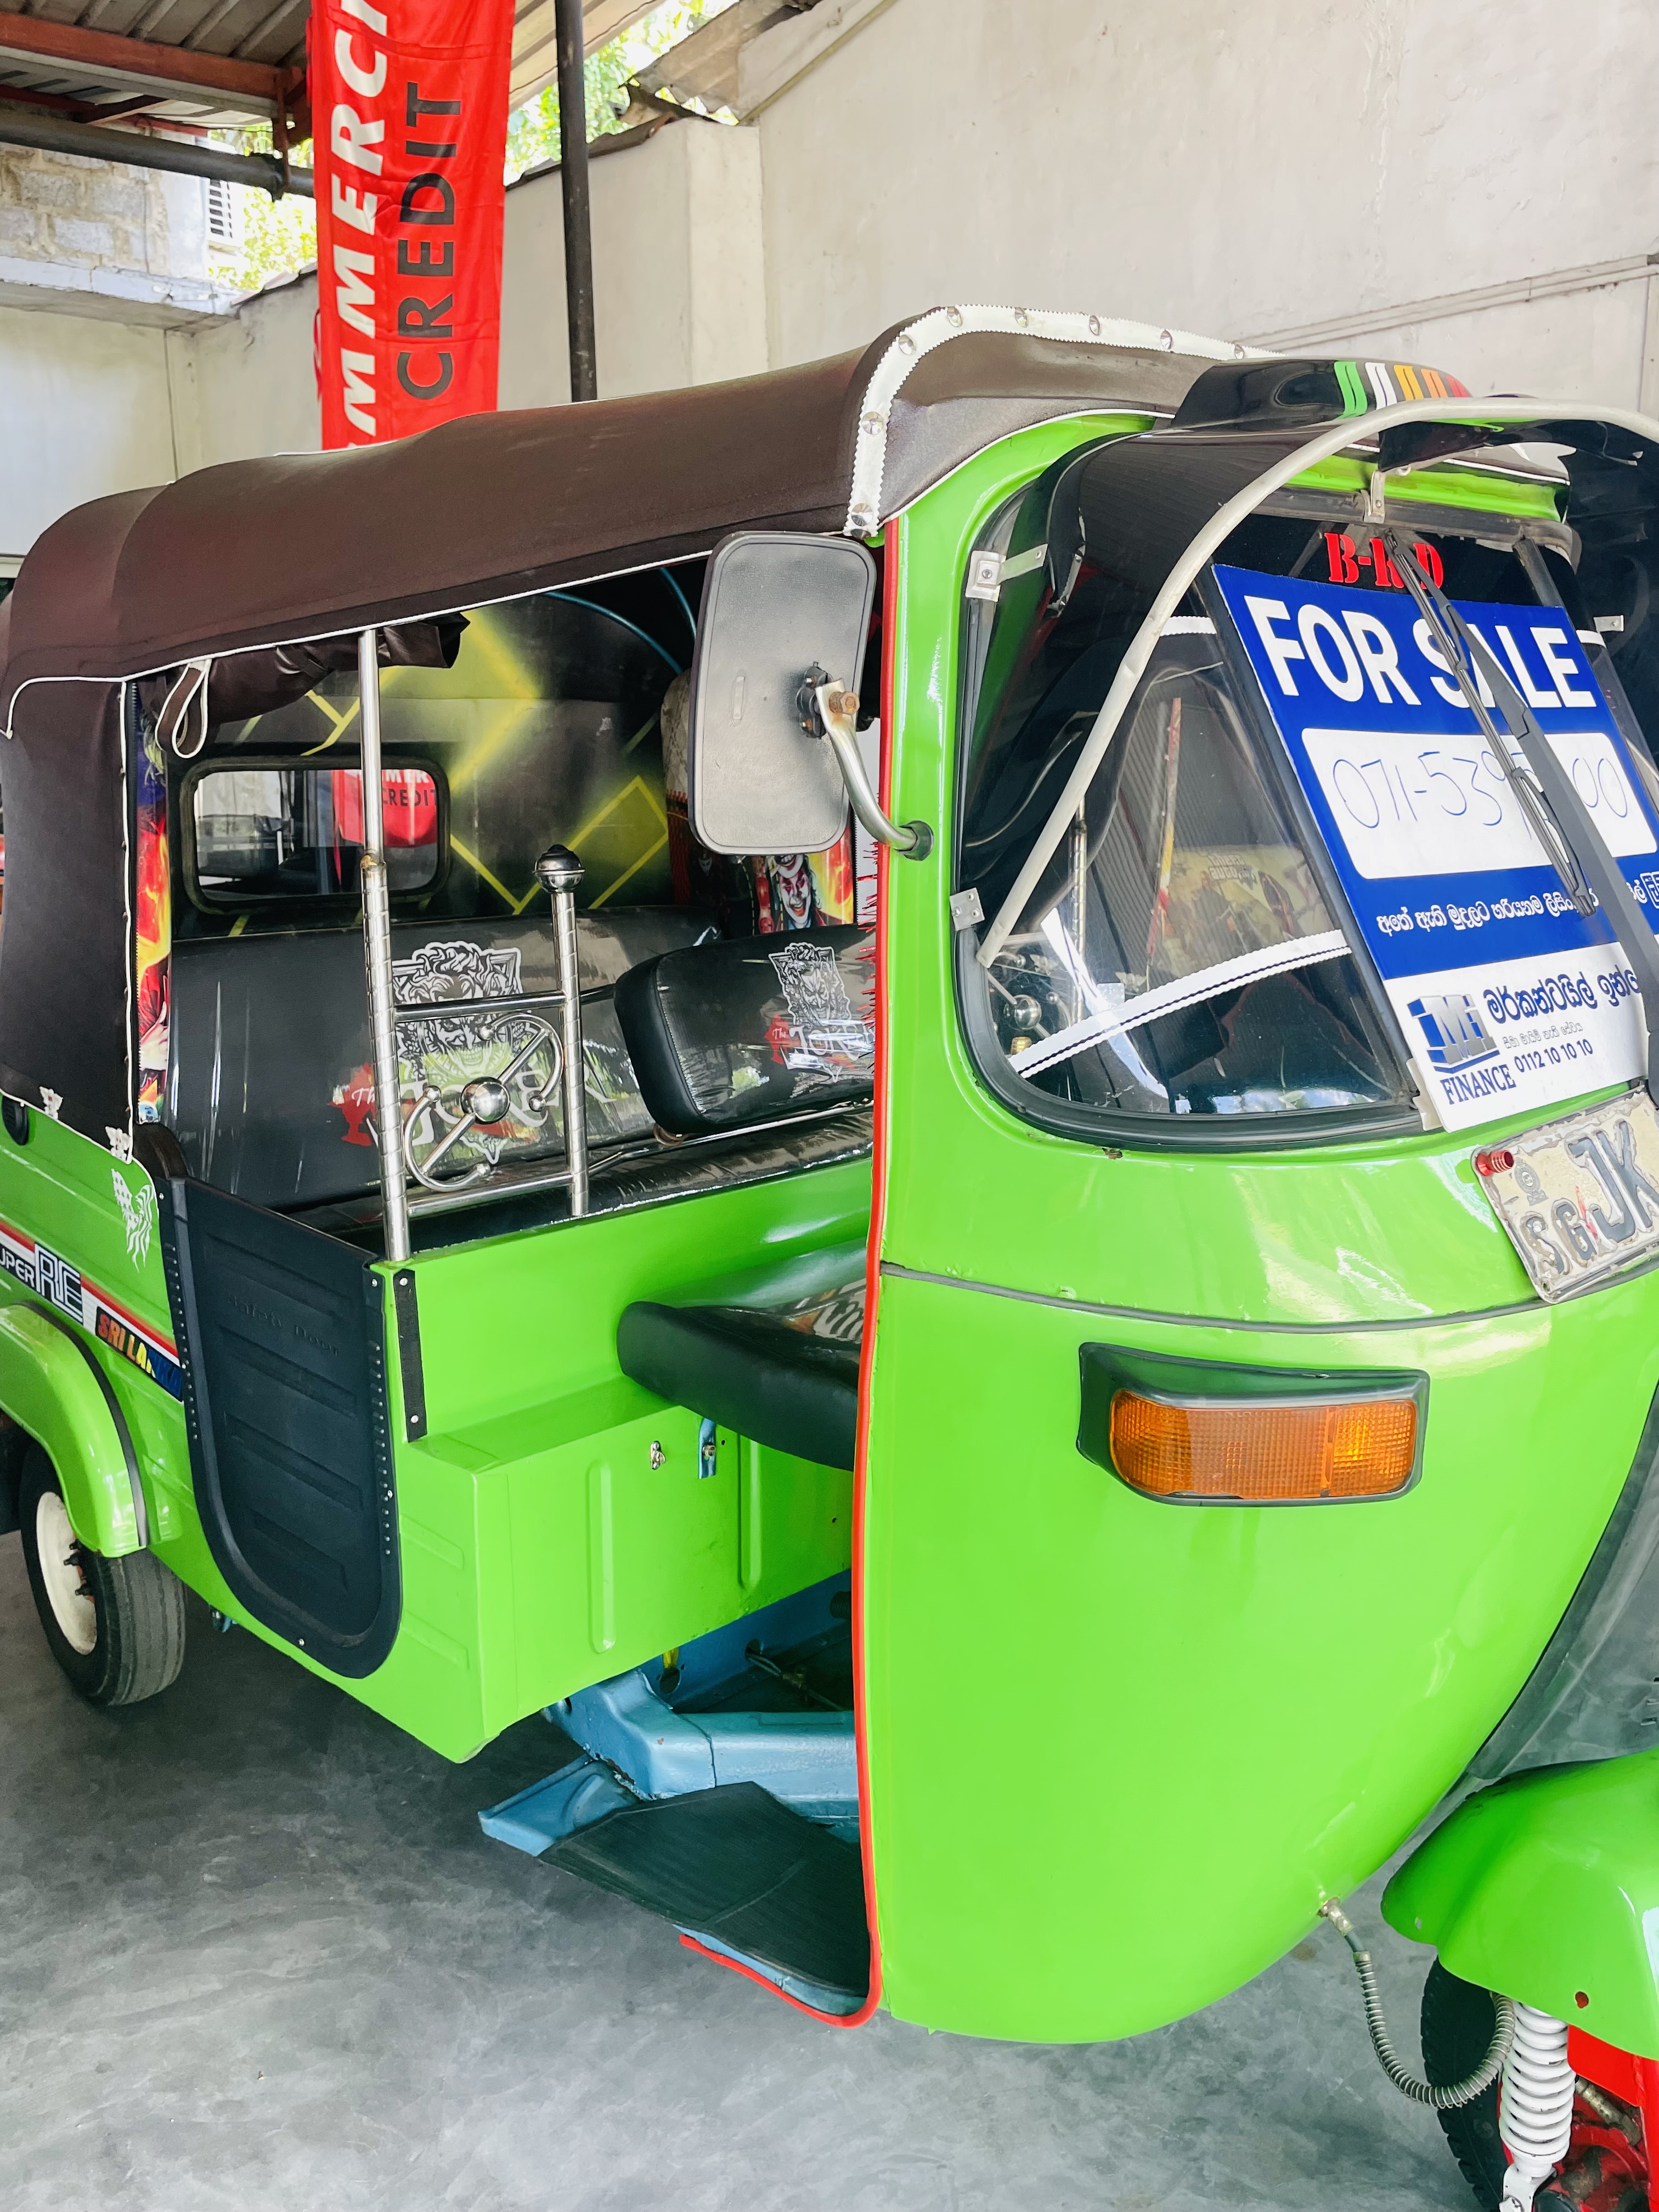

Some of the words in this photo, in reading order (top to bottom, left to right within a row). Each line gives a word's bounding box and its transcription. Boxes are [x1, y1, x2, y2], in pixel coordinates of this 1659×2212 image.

[397, 82, 461, 400] CREDIT
[1244, 595, 1422, 706] FOR
[1440, 1064, 1517, 1105] FINANCE
[1514, 1051, 1546, 1073] 0112
[1544, 1047, 1561, 1064] 10
[1560, 1042, 1577, 1060] 10
[1577, 1039, 1593, 1056] 10
[1568, 1120, 1659, 1244] JK
[99, 1314, 126, 1351] SRI
